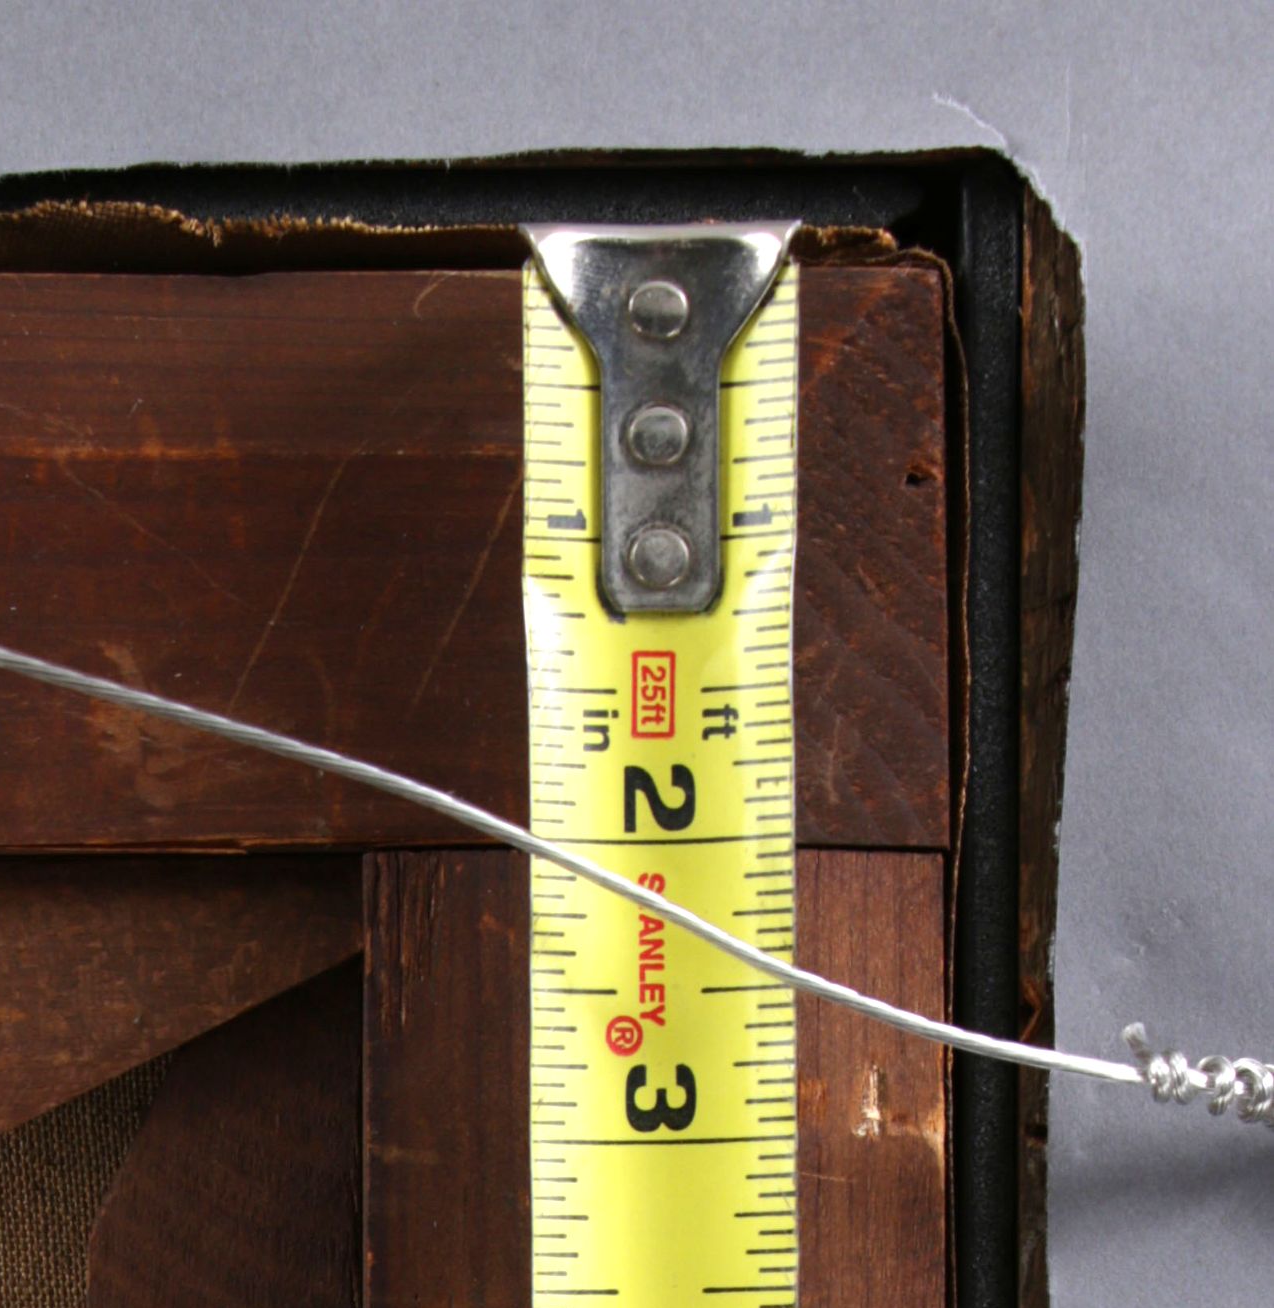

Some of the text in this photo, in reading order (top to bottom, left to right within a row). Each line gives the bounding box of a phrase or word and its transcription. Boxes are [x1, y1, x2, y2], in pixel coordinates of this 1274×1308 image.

[547, 509, 587, 531] 1
[733, 503, 772, 527] 1
[640, 666, 667, 726] 25ft
[583, 708, 619, 752] in
[701, 704, 739, 741] ft
[624, 764, 696, 833] 2
[637, 873, 666, 1027] SANLEY
[626, 1063, 697, 1133] 3
